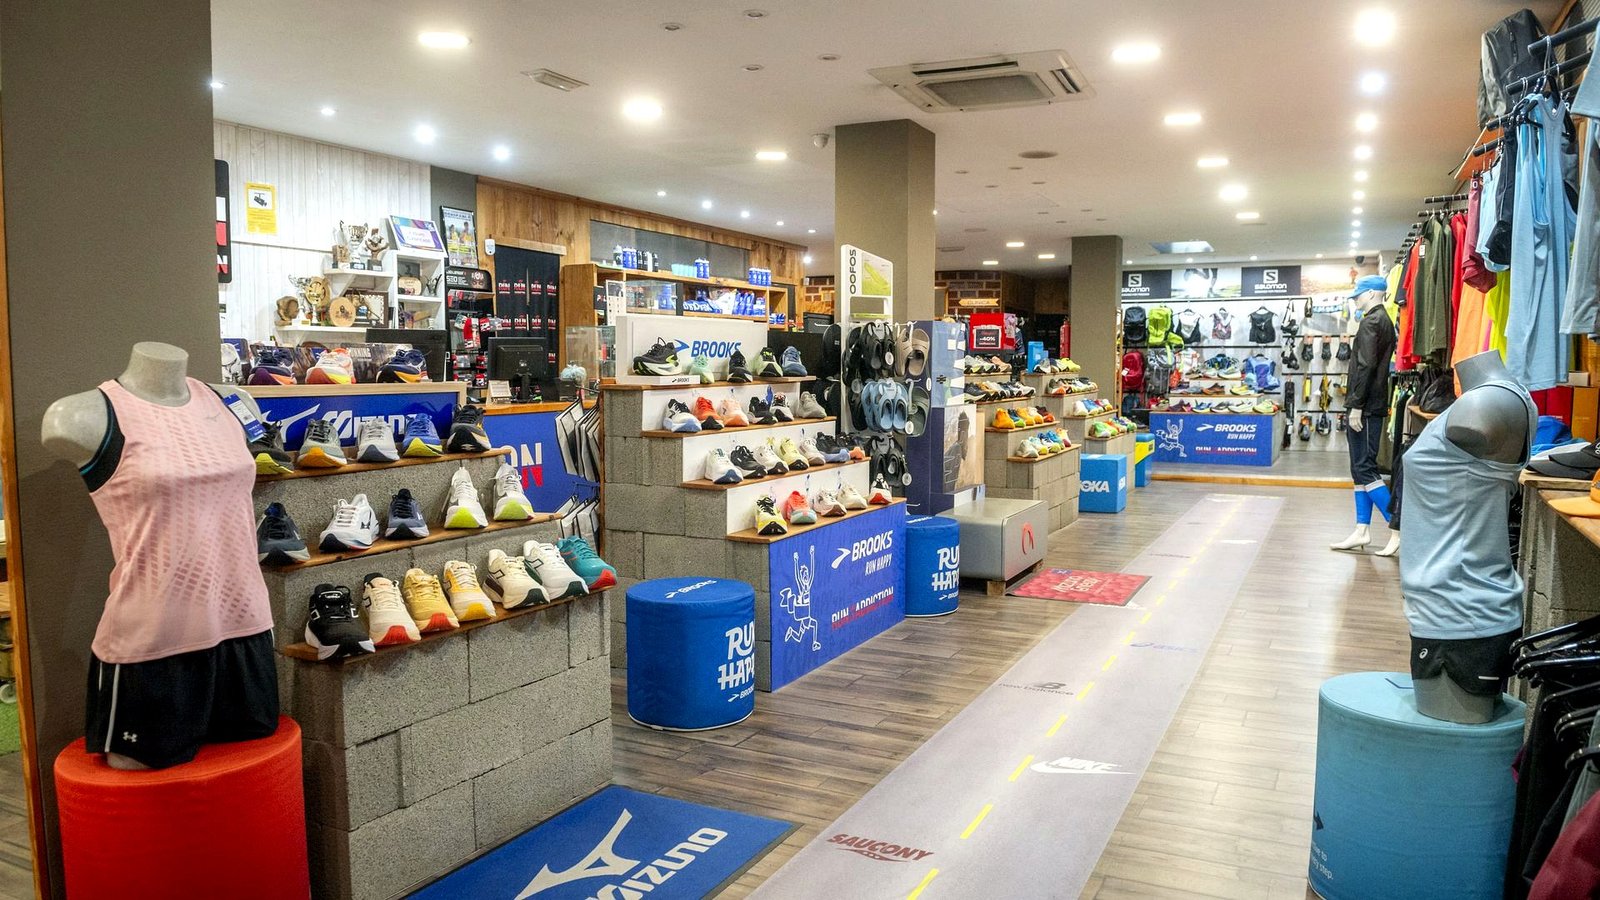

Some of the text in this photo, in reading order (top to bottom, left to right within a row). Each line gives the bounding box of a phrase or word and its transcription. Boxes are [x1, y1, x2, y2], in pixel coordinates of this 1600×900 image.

[849, 249, 857, 295] OOFOS
[1214, 423, 1258, 432] BROOKS
[1195, 446, 1258, 456] RUN ADDICTION
[1079, 480, 1110, 493] OKA
[851, 530, 894, 562] BROOKS
[865, 553, 893, 576] RUN HAPPY
[937, 545, 960, 571] RU
[677, 580, 718, 593] BROOKS
[832, 586, 894, 630] RUN ADDICTION
[726, 620, 755, 660] RU
[1024, 686, 1074, 695] balance
[1047, 756, 1122, 770] NIKE
[826, 833, 935, 861] SAUCONY
